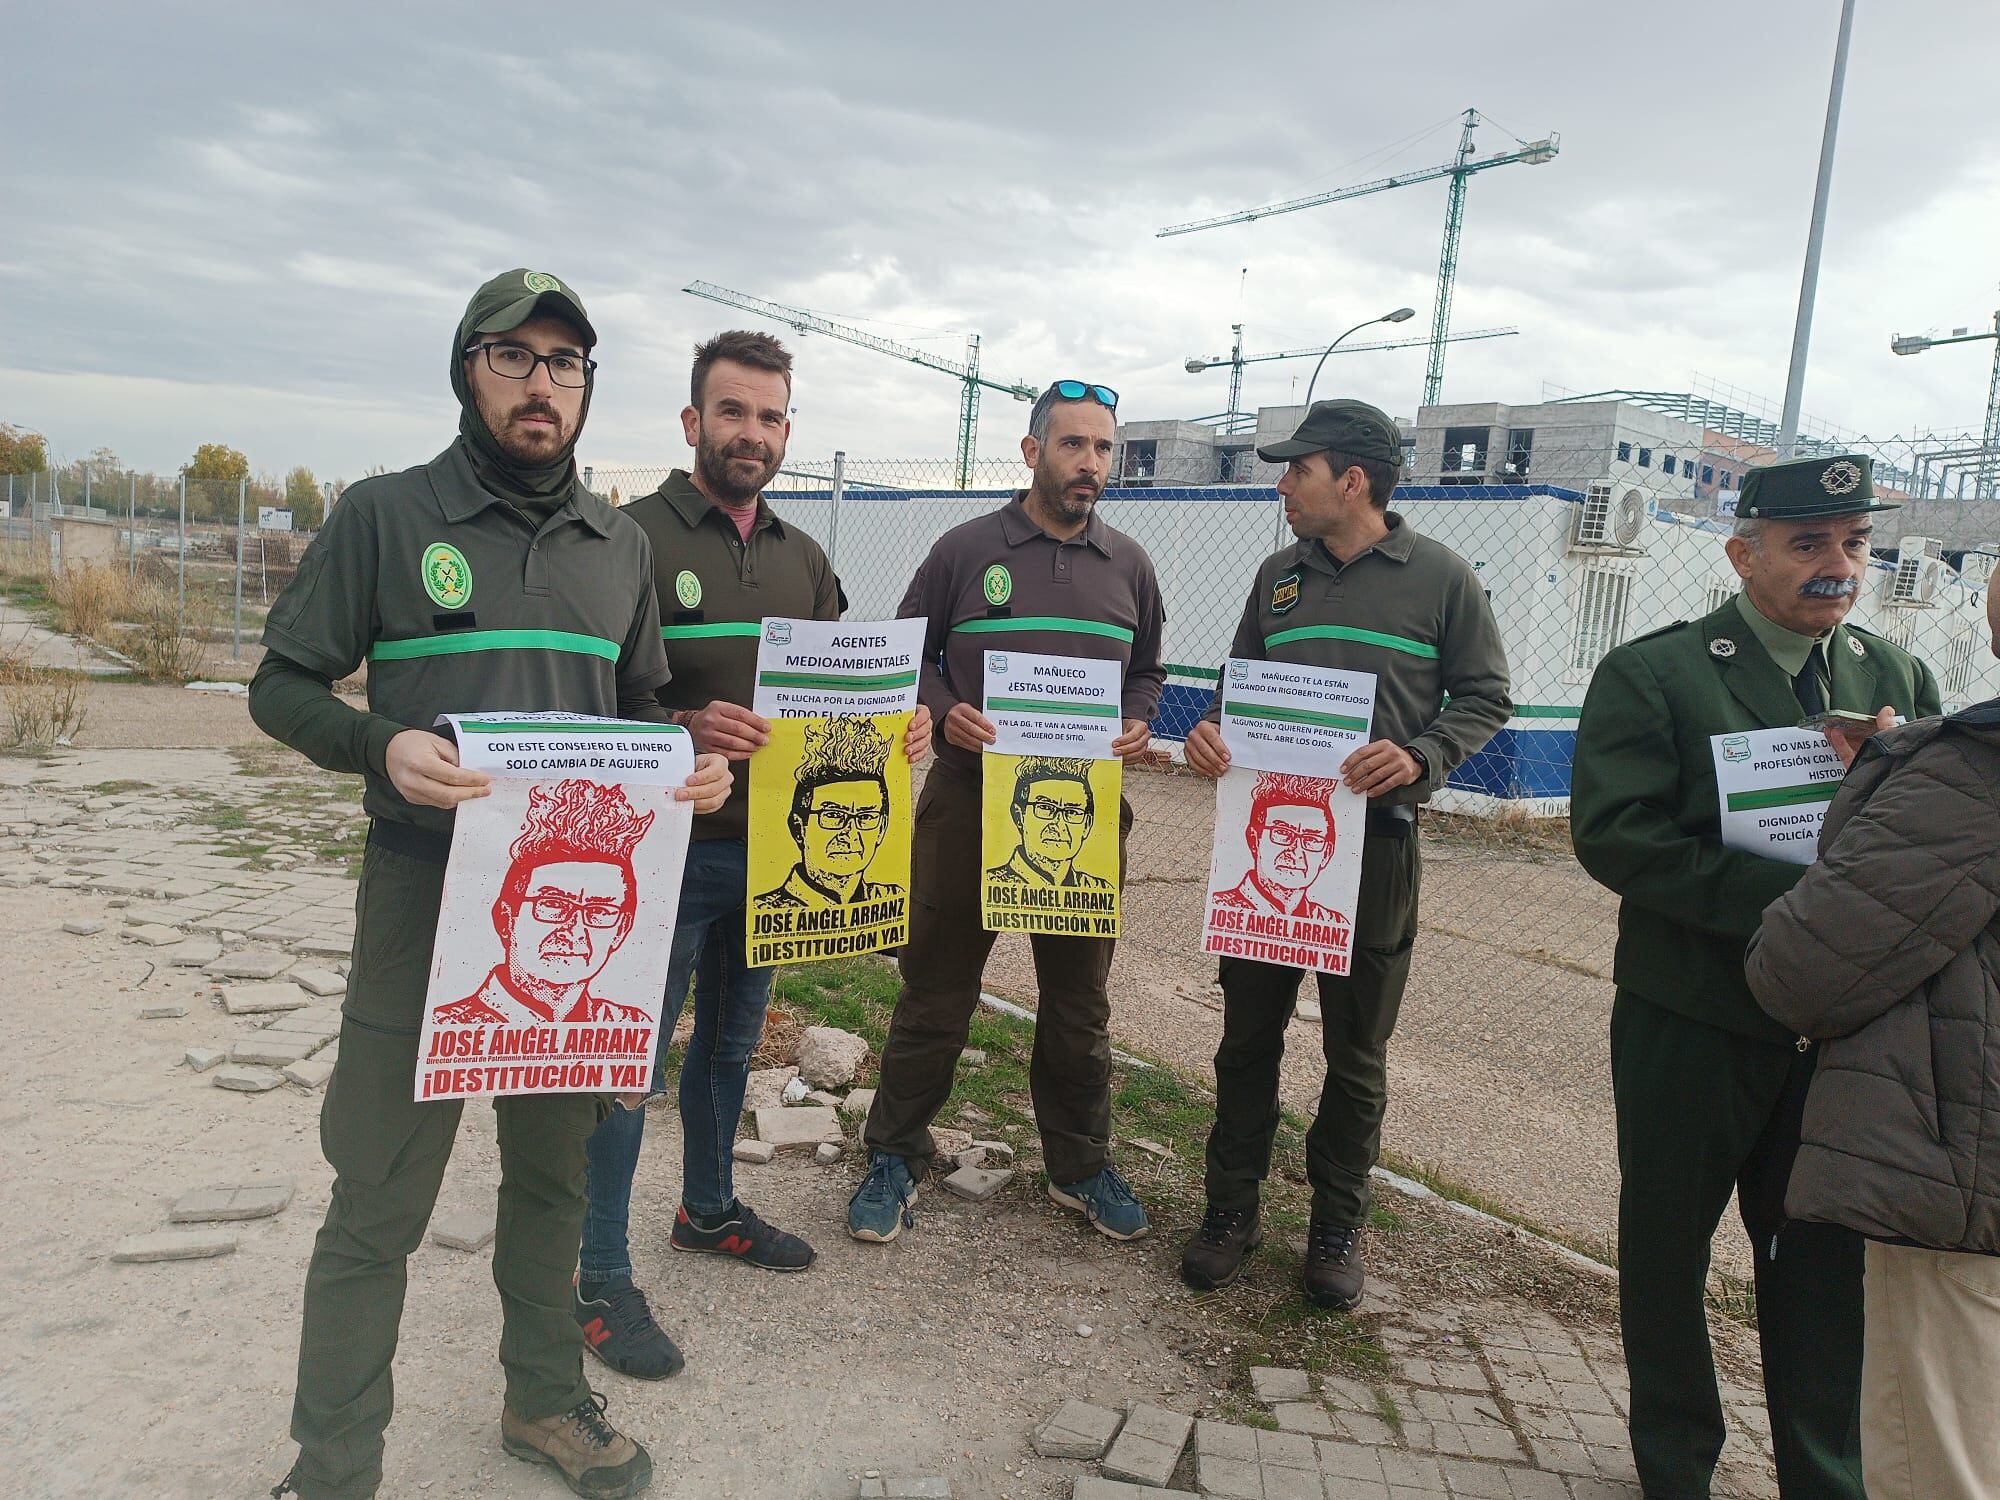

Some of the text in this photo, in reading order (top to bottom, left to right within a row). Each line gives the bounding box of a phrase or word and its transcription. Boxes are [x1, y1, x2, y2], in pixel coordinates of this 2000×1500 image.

[831, 636, 886, 648] AGENTES
[786, 654, 910, 670] MEDIOAMBIENTALES
[1034, 666, 1086, 678] MAÑUECO
[1262, 672, 1300, 682] MAÑUECO
[1313, 678, 1322, 686] LA
[1324, 678, 1349, 689] ESTÁN
[1008, 682, 1104, 697] ¿ESTAS QUEMADO?
[1231, 682, 1265, 692] JUGANDO
[1278, 687, 1322, 698] RIGOBERTO
[1324, 692, 1370, 705] CORTEJOSO
[776, 694, 789, 702] EN
[791, 695, 822, 704] LUCHA
[824, 696, 842, 704] POR
[858, 695, 896, 706] DIGNIDAD
[897, 694, 906, 702] DE
[779, 708, 818, 718] TODO
[1067, 723, 1098, 732] CAMBIAR
[1232, 718, 1356, 740] ALGUNOS NO QUIEREN PERDER SU
[1022, 732, 1054, 740] AGUJERO
[1066, 734, 1086, 742] SITIO.
[1274, 735, 1294, 744] ABRE
[1312, 739, 1334, 748] OJOS.
[488, 742, 672, 752] CON ESTE CONSEJERO EL DINERO
[1772, 743, 1788, 752] NO
[1790, 740, 1811, 750] VAIS
[1814, 740, 1820, 748] A
[506, 758, 659, 770] SOLO CAMBIA DE AGUJERO
[1754, 755, 1811, 771] PROFESIÓN
[1814, 754, 1834, 764] CON
[1809, 768, 1847, 780] HISTORI
[1759, 814, 1814, 828] DIGNIDAD
[1770, 828, 1814, 842] POLICÍA
[987, 884, 1114, 910] JOSÉ ÁNGEL ARRANZ
[754, 898, 905, 934] JOSÉ ÁNGEL ARRANZ
[987, 912, 1116, 934] ¡DESTITUCIÓN YA!
[1210, 908, 1350, 947] JOSÉ ÁNGEL ARRANZ
[752, 925, 904, 965] ¡DESTITUCIÓN YA!
[1206, 935, 1348, 972] ¡DESTITUCIÓN YA!
[428, 1024, 651, 1058] JOSÉ ÁNGEL ARRANZ
[453, 1056, 478, 1064] General
[423, 1062, 648, 1098] ¡DESTITUCIÓN YA!
